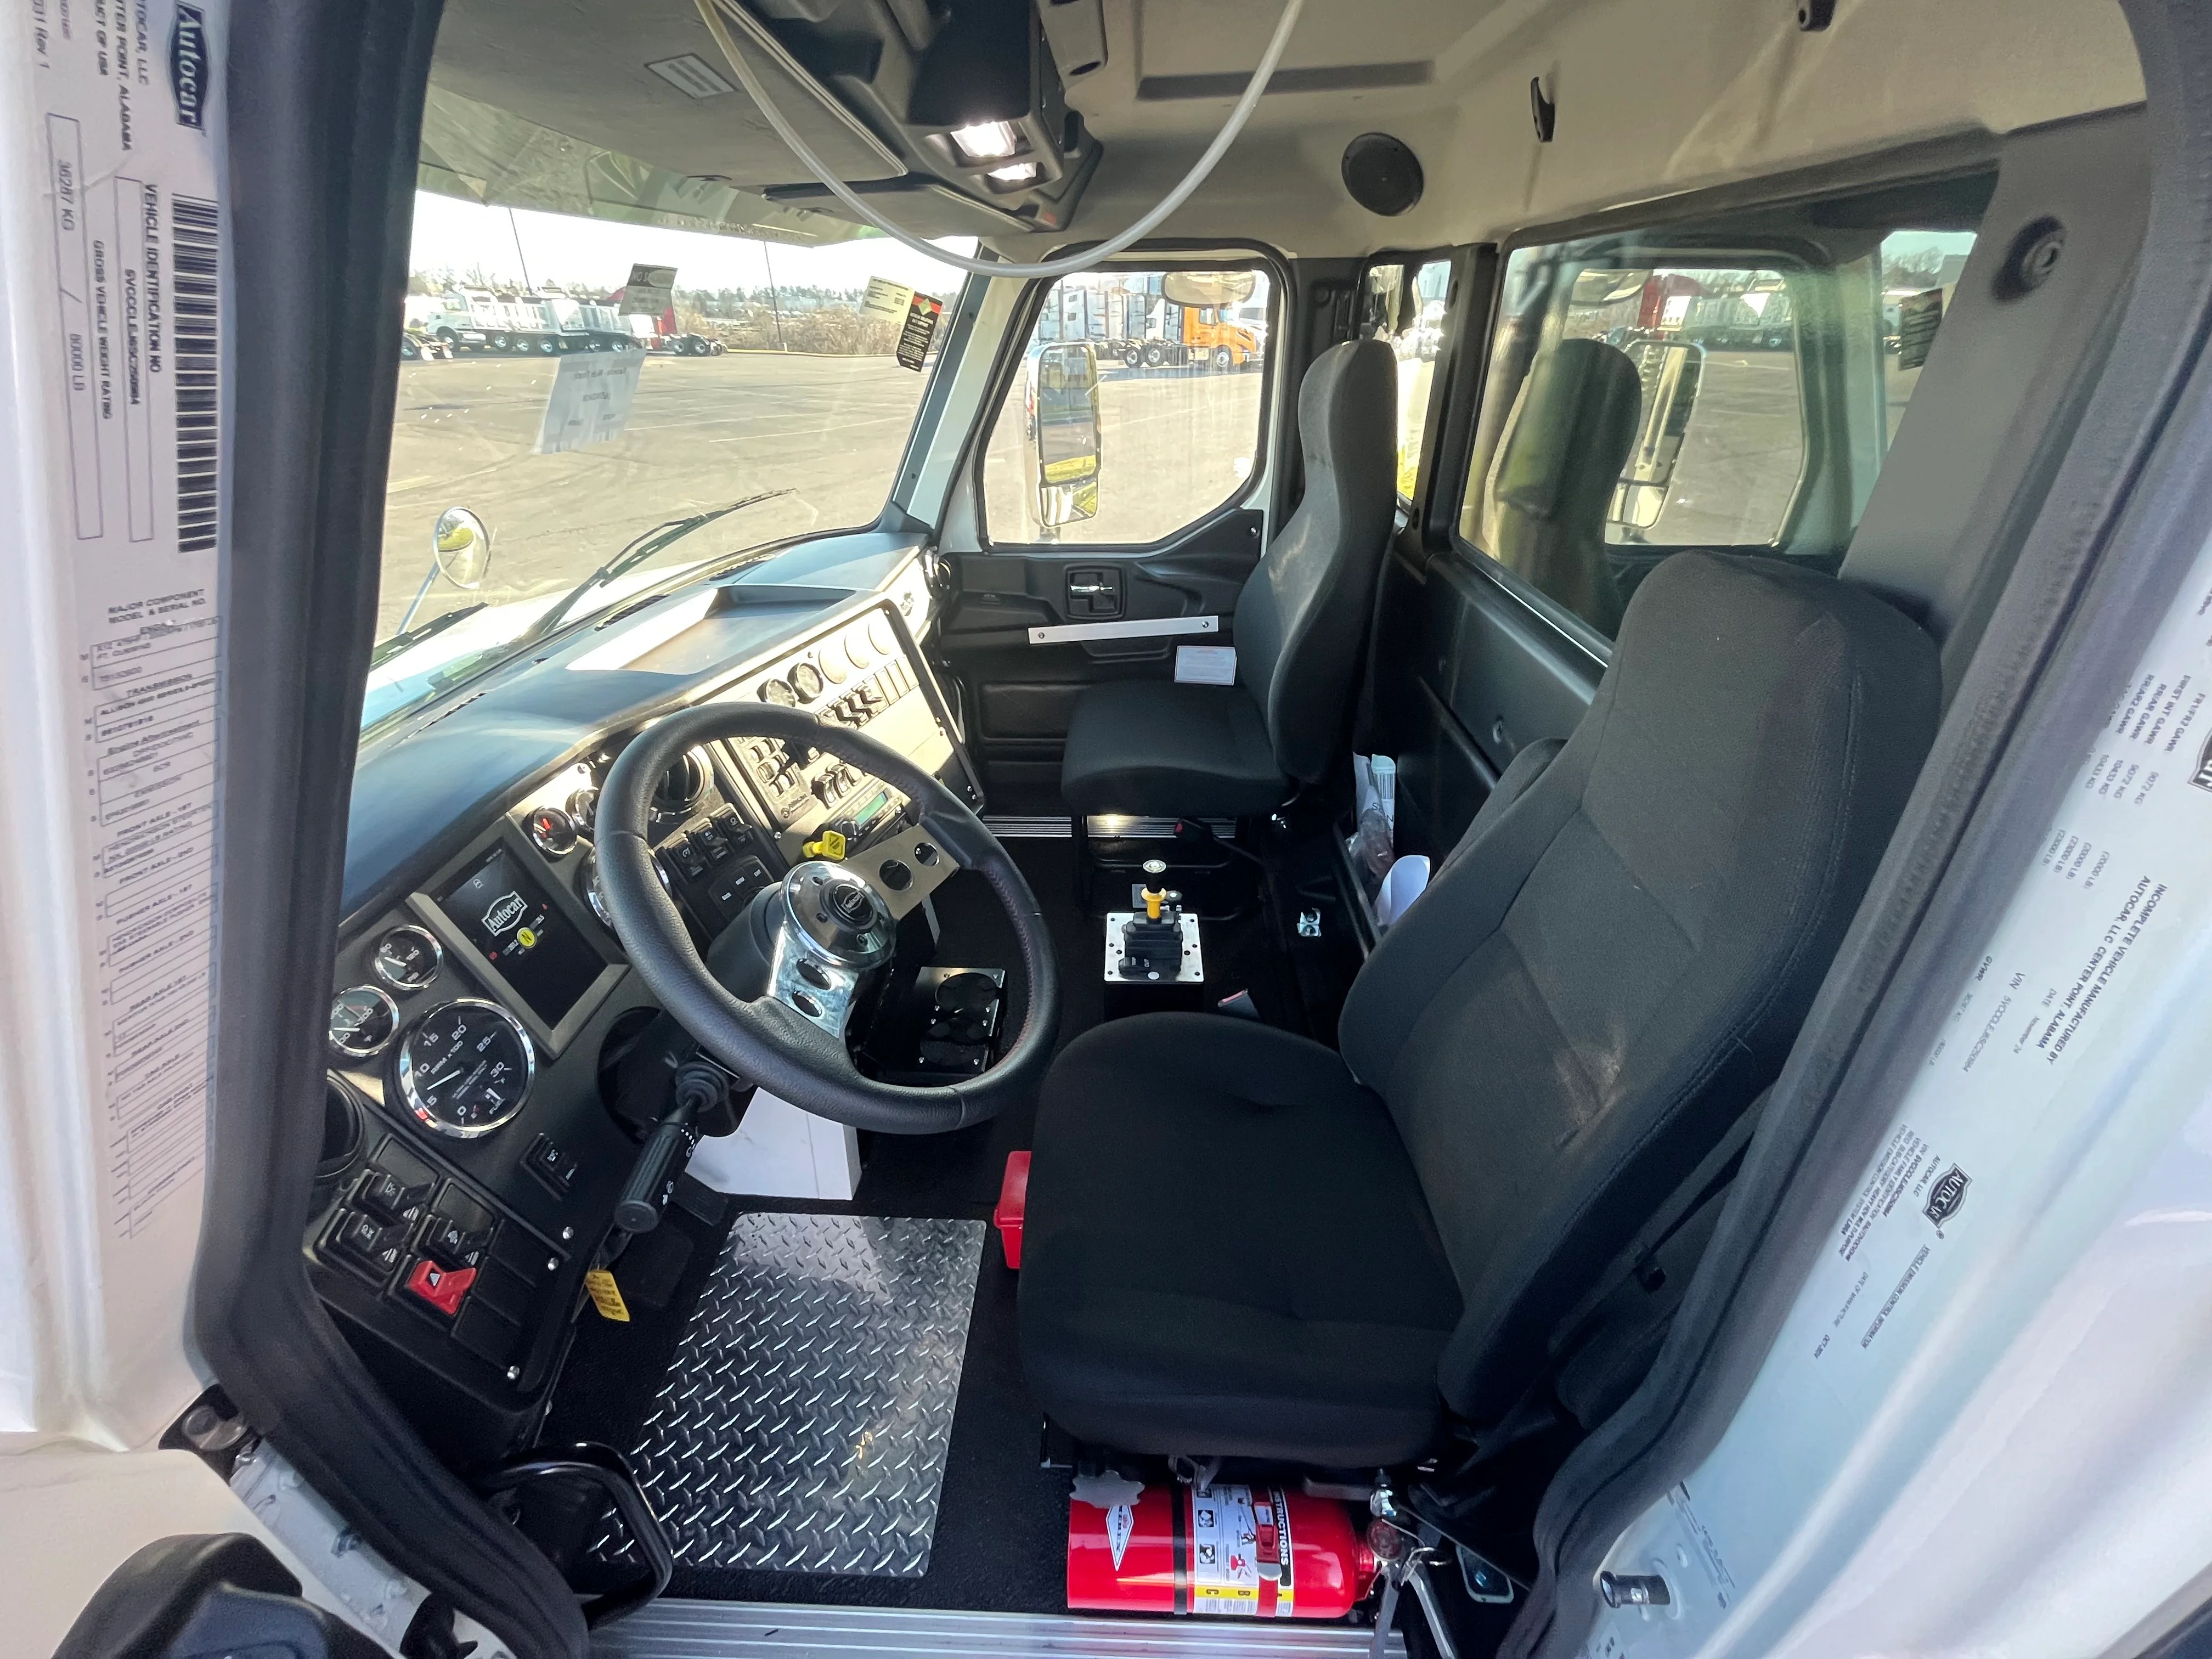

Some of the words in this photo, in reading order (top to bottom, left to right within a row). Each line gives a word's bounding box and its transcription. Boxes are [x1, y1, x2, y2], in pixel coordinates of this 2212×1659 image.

[178, 9, 202, 124] Autocar
[144, 184, 159, 244] VEHICLE
[145, 247, 161, 351] IDENTIFICATION
[2114, 706, 2136, 735] GAWR
[2129, 710, 2151, 740] GAWR
[2144, 716, 2166, 746] GAWR
[488, 898, 523, 931] Autocar
[2123, 882, 2168, 947] INCOMPLETE
[2103, 923, 2120, 944] LLC
[1974, 955, 1994, 981] GVWR
[2078, 944, 2107, 984] CENTER
[2096, 943, 2127, 986] VEHICLE
[2008, 970, 2025, 990] VIN
[2036, 1008, 2066, 1050] ALABAMA
[2053, 982, 2102, 1053] MANUFACTURED
[424, 1033, 439, 1046] 15
[452, 1024, 466, 1041] 20
[477, 1036, 491, 1053] 25
[414, 1063, 430, 1077] 10
[490, 1062, 505, 1077] 30
[2045, 1051, 2058, 1065] BY
[457, 1105, 466, 1116] 0
